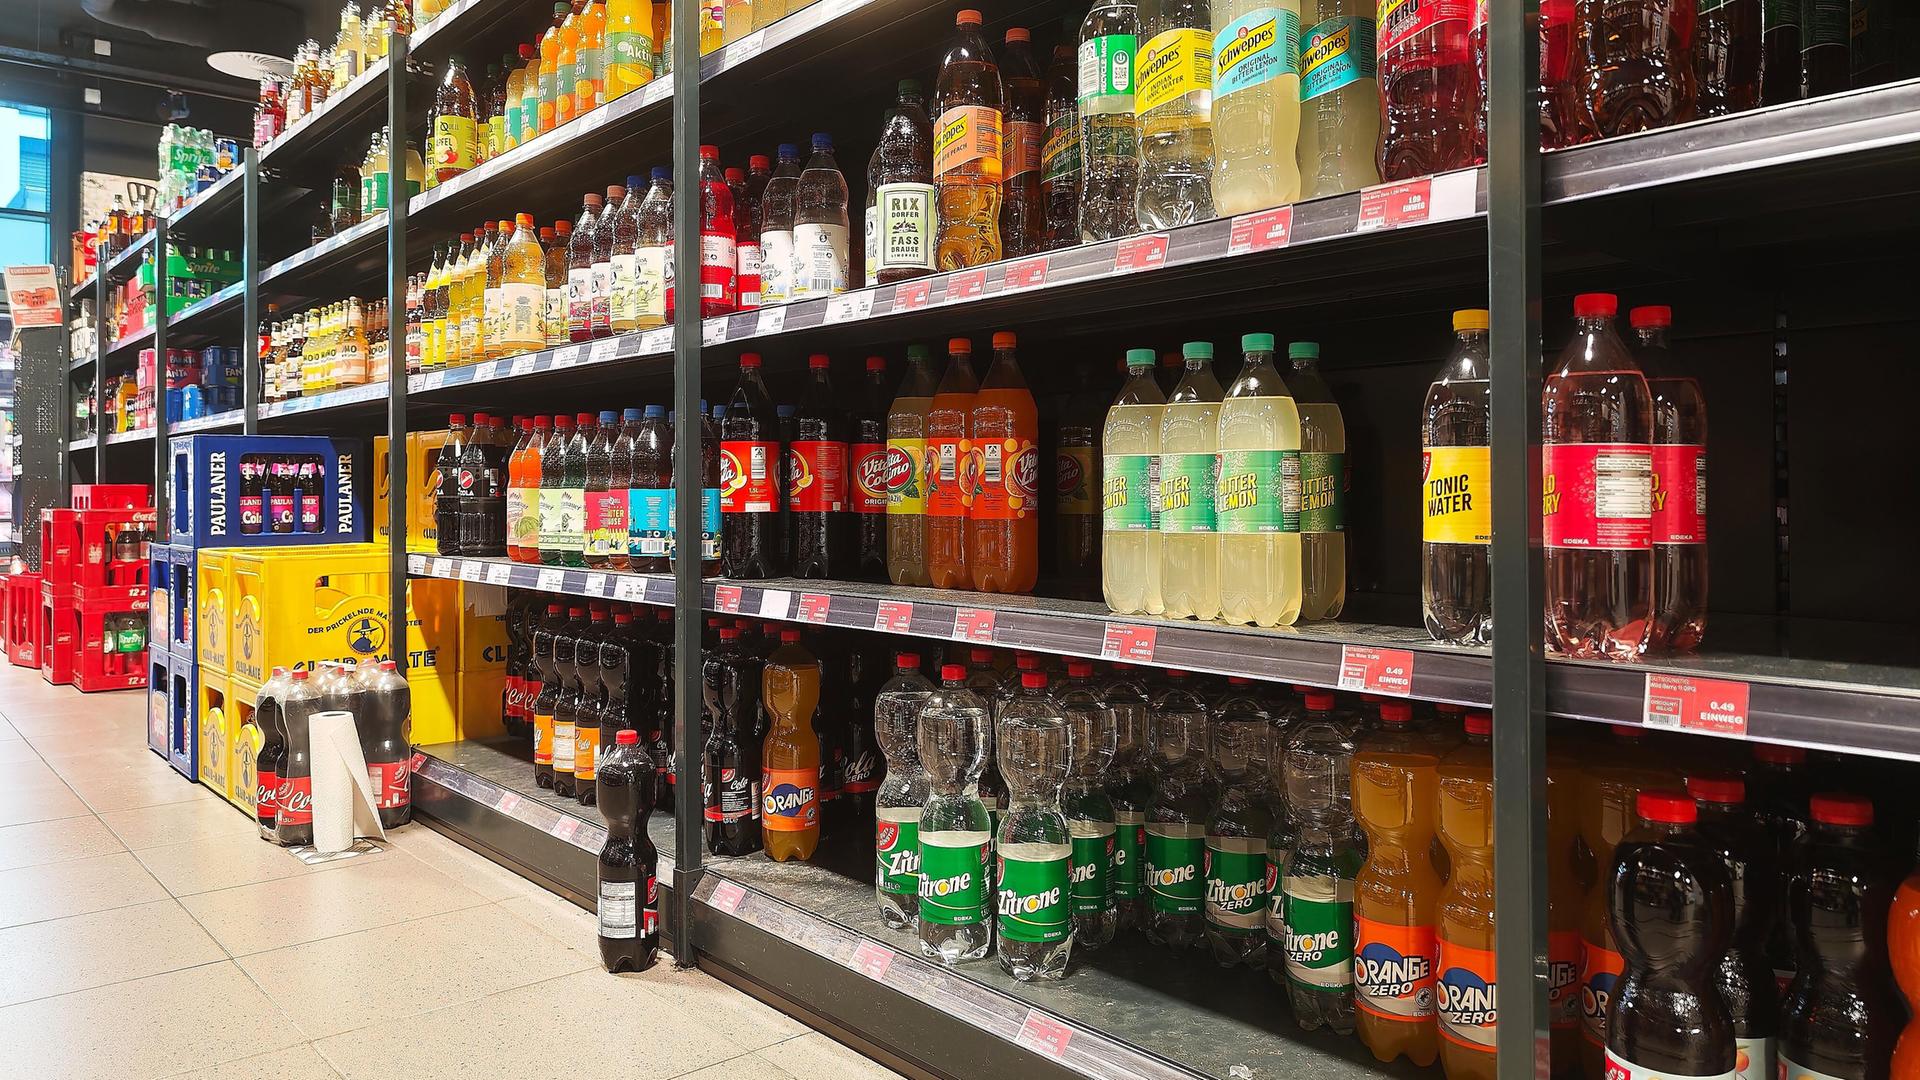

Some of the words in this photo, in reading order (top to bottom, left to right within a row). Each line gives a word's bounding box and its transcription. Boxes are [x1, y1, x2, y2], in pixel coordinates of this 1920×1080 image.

[1218, 29, 1273, 75] Schweppes
[1232, 66, 1255, 84] BITTER
[1256, 55, 1278, 72] LEMON
[1238, 53, 1270, 73] ORIGINAL
[1312, 60, 1344, 81] ORIGINAL
[1150, 73, 1172, 92] INDIAN
[1161, 75, 1184, 91] WATER
[1306, 74, 1328, 93] BITTER
[1329, 63, 1351, 81] LEMON
[174, 148, 210, 164] Sprite
[951, 142, 968, 156] PEACH
[892, 197, 919, 211] RIX
[891, 236, 919, 245] FASS
[186, 261, 220, 274] Sprite
[166, 368, 188, 378] ANTA
[225, 367, 246, 377] FAN
[1219, 473, 1258, 496] BITTER
[1430, 474, 1469, 498] TONIC
[211, 451, 226, 536] PAULANER
[338, 453, 352, 534] PAULANER
[1219, 489, 1258, 513] LEMON
[1300, 490, 1335, 512] EMON
[1428, 493, 1472, 518] WATER
[129, 588, 139, 597] 12
[326, 608, 375, 632] PRICKELNDE
[1386, 666, 1403, 675] 0.49
[128, 676, 139, 685] 12
[1378, 675, 1409, 685] EINWEG
[1663, 683, 1677, 691] Berry
[1710, 701, 1735, 711] 0.49
[1700, 711, 1744, 724] EINWEG
[731, 777, 749, 790] Cola
[845, 770, 871, 784] ZERO
[764, 786, 815, 815] ORANGE
[1207, 878, 1266, 903] Zitrone
[1219, 898, 1252, 911] ZERO
[1043, 931, 1062, 939] EDEKA
[1289, 951, 1322, 962] ZERO
[1354, 956, 1429, 985] ORANGE
[1369, 981, 1413, 996] ZERO
[1451, 1010, 1496, 1024] ZERO
